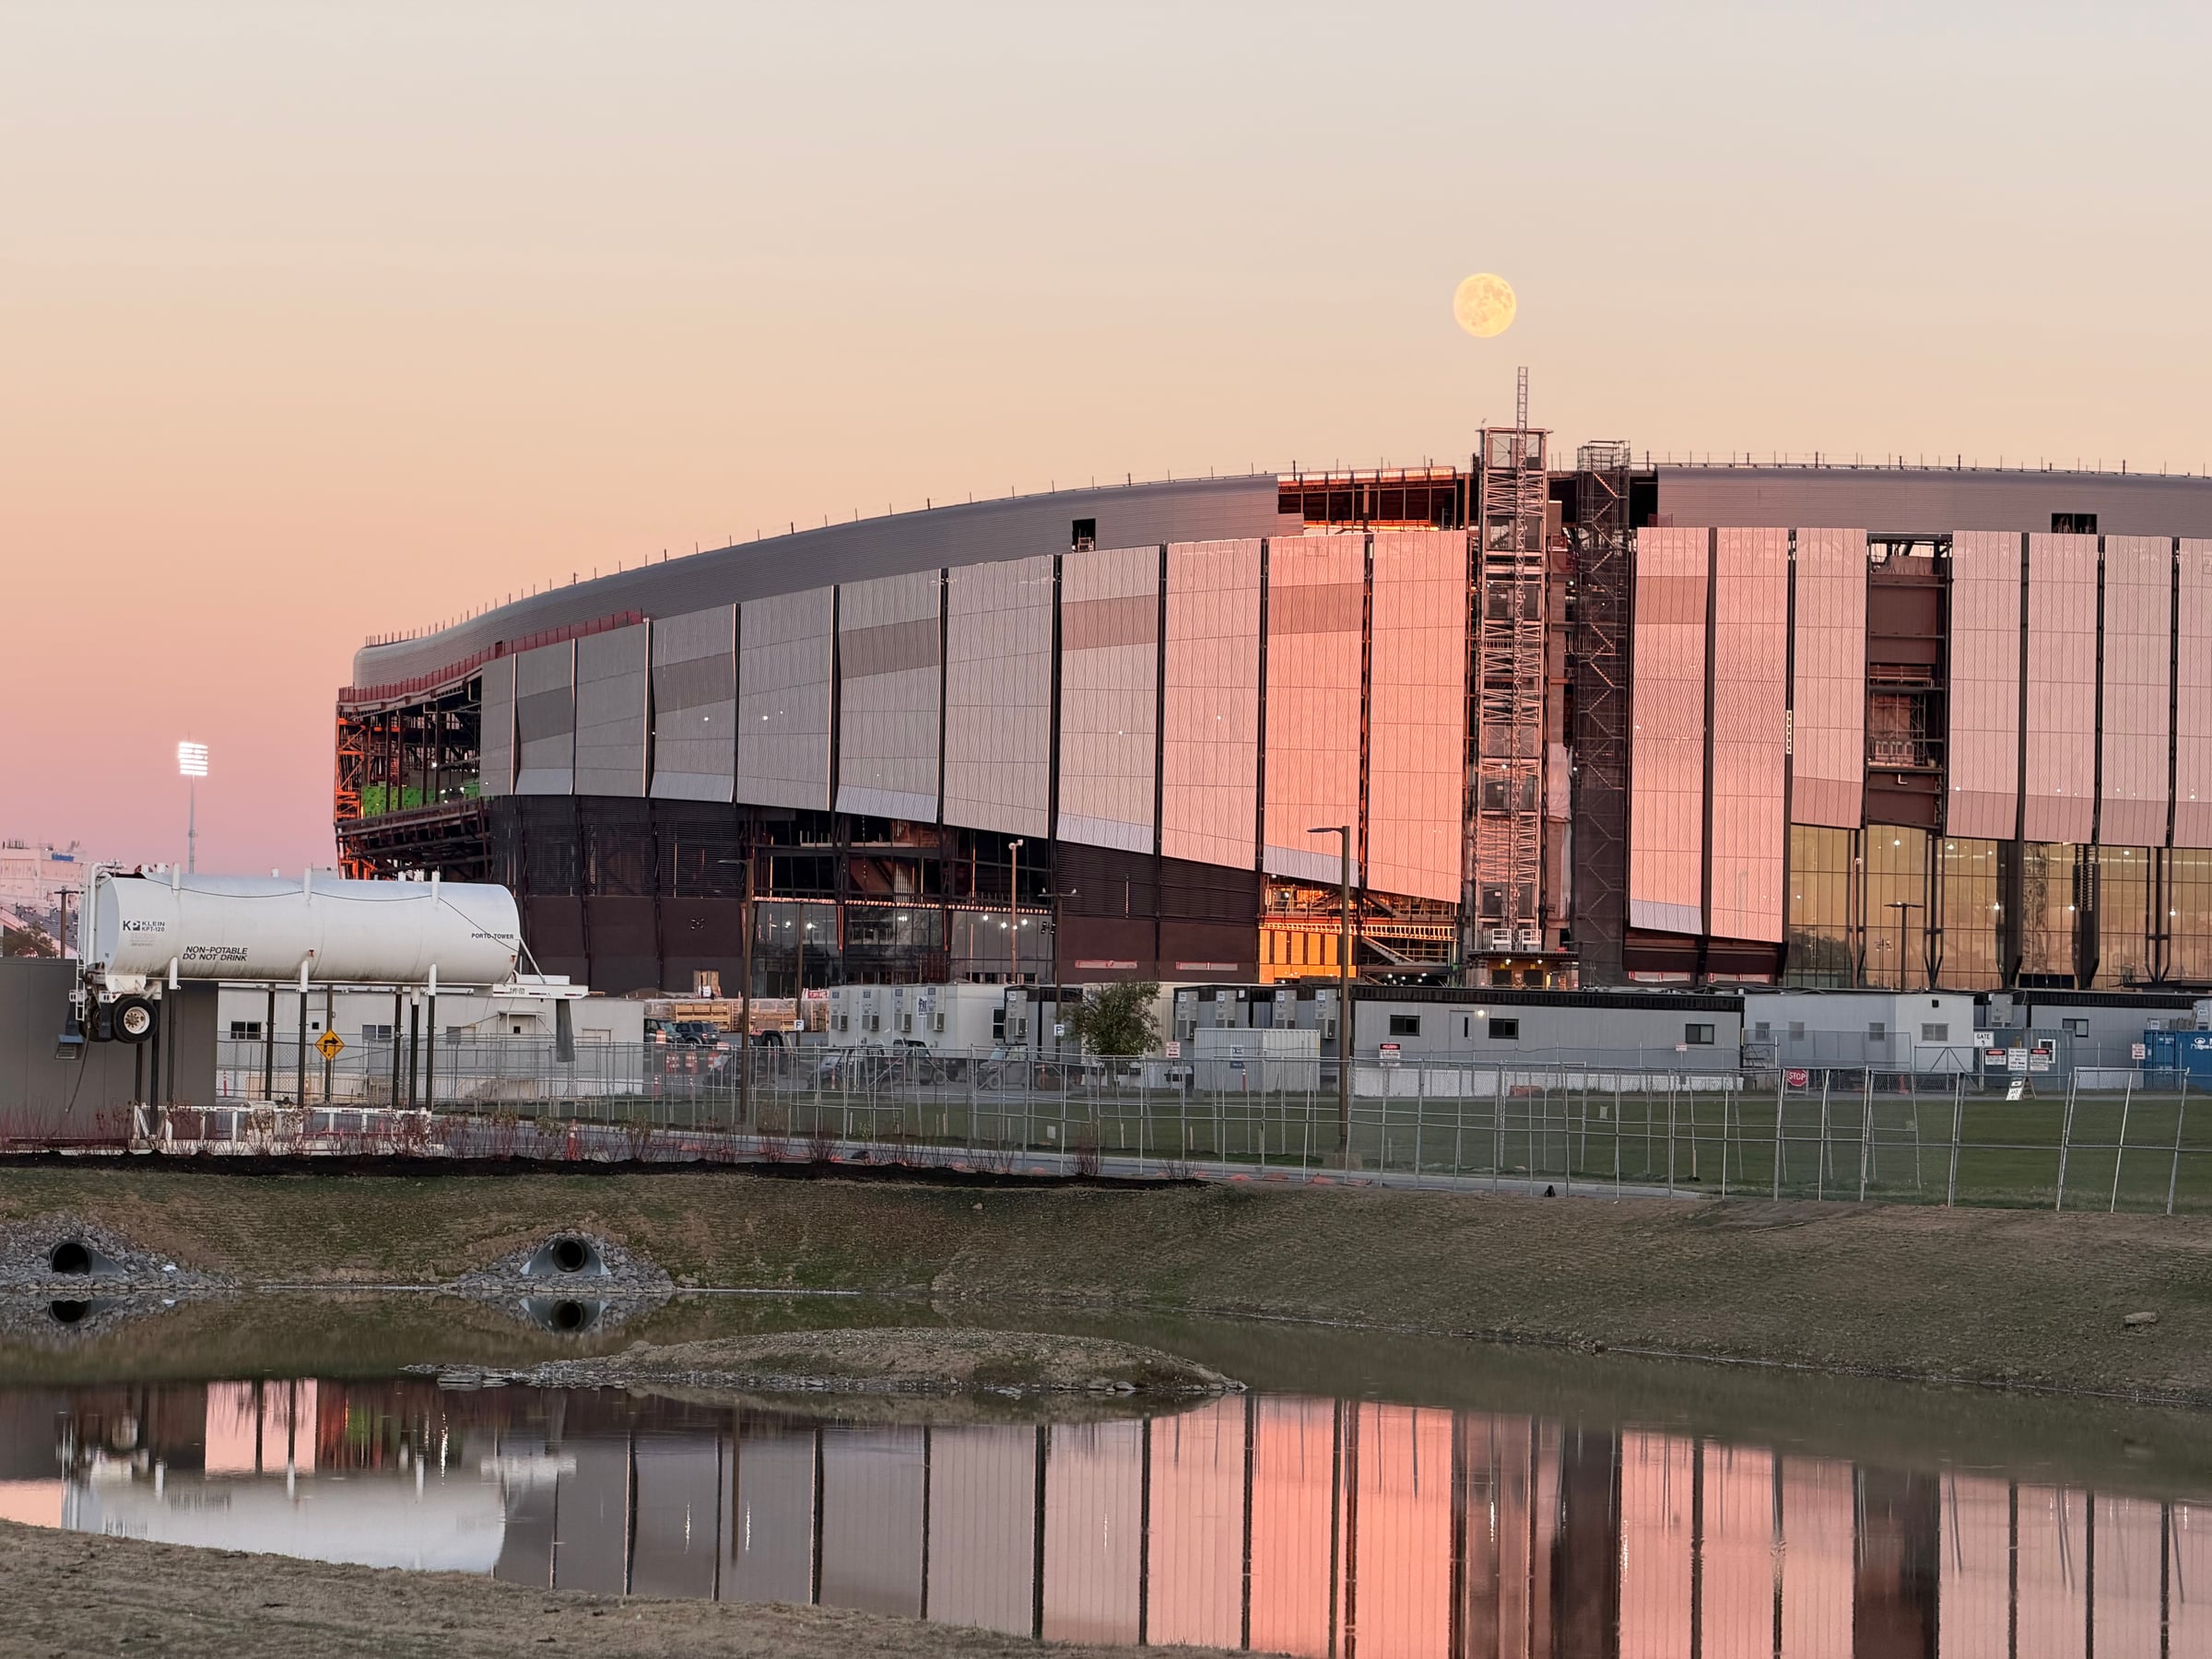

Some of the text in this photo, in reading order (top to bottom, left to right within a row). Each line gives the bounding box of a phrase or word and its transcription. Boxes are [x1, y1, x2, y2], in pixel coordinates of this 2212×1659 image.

[185, 946, 248, 955] NON-POTABLE
[795, 1021, 802, 1030] F
[1789, 1072, 1806, 1081] STOP
